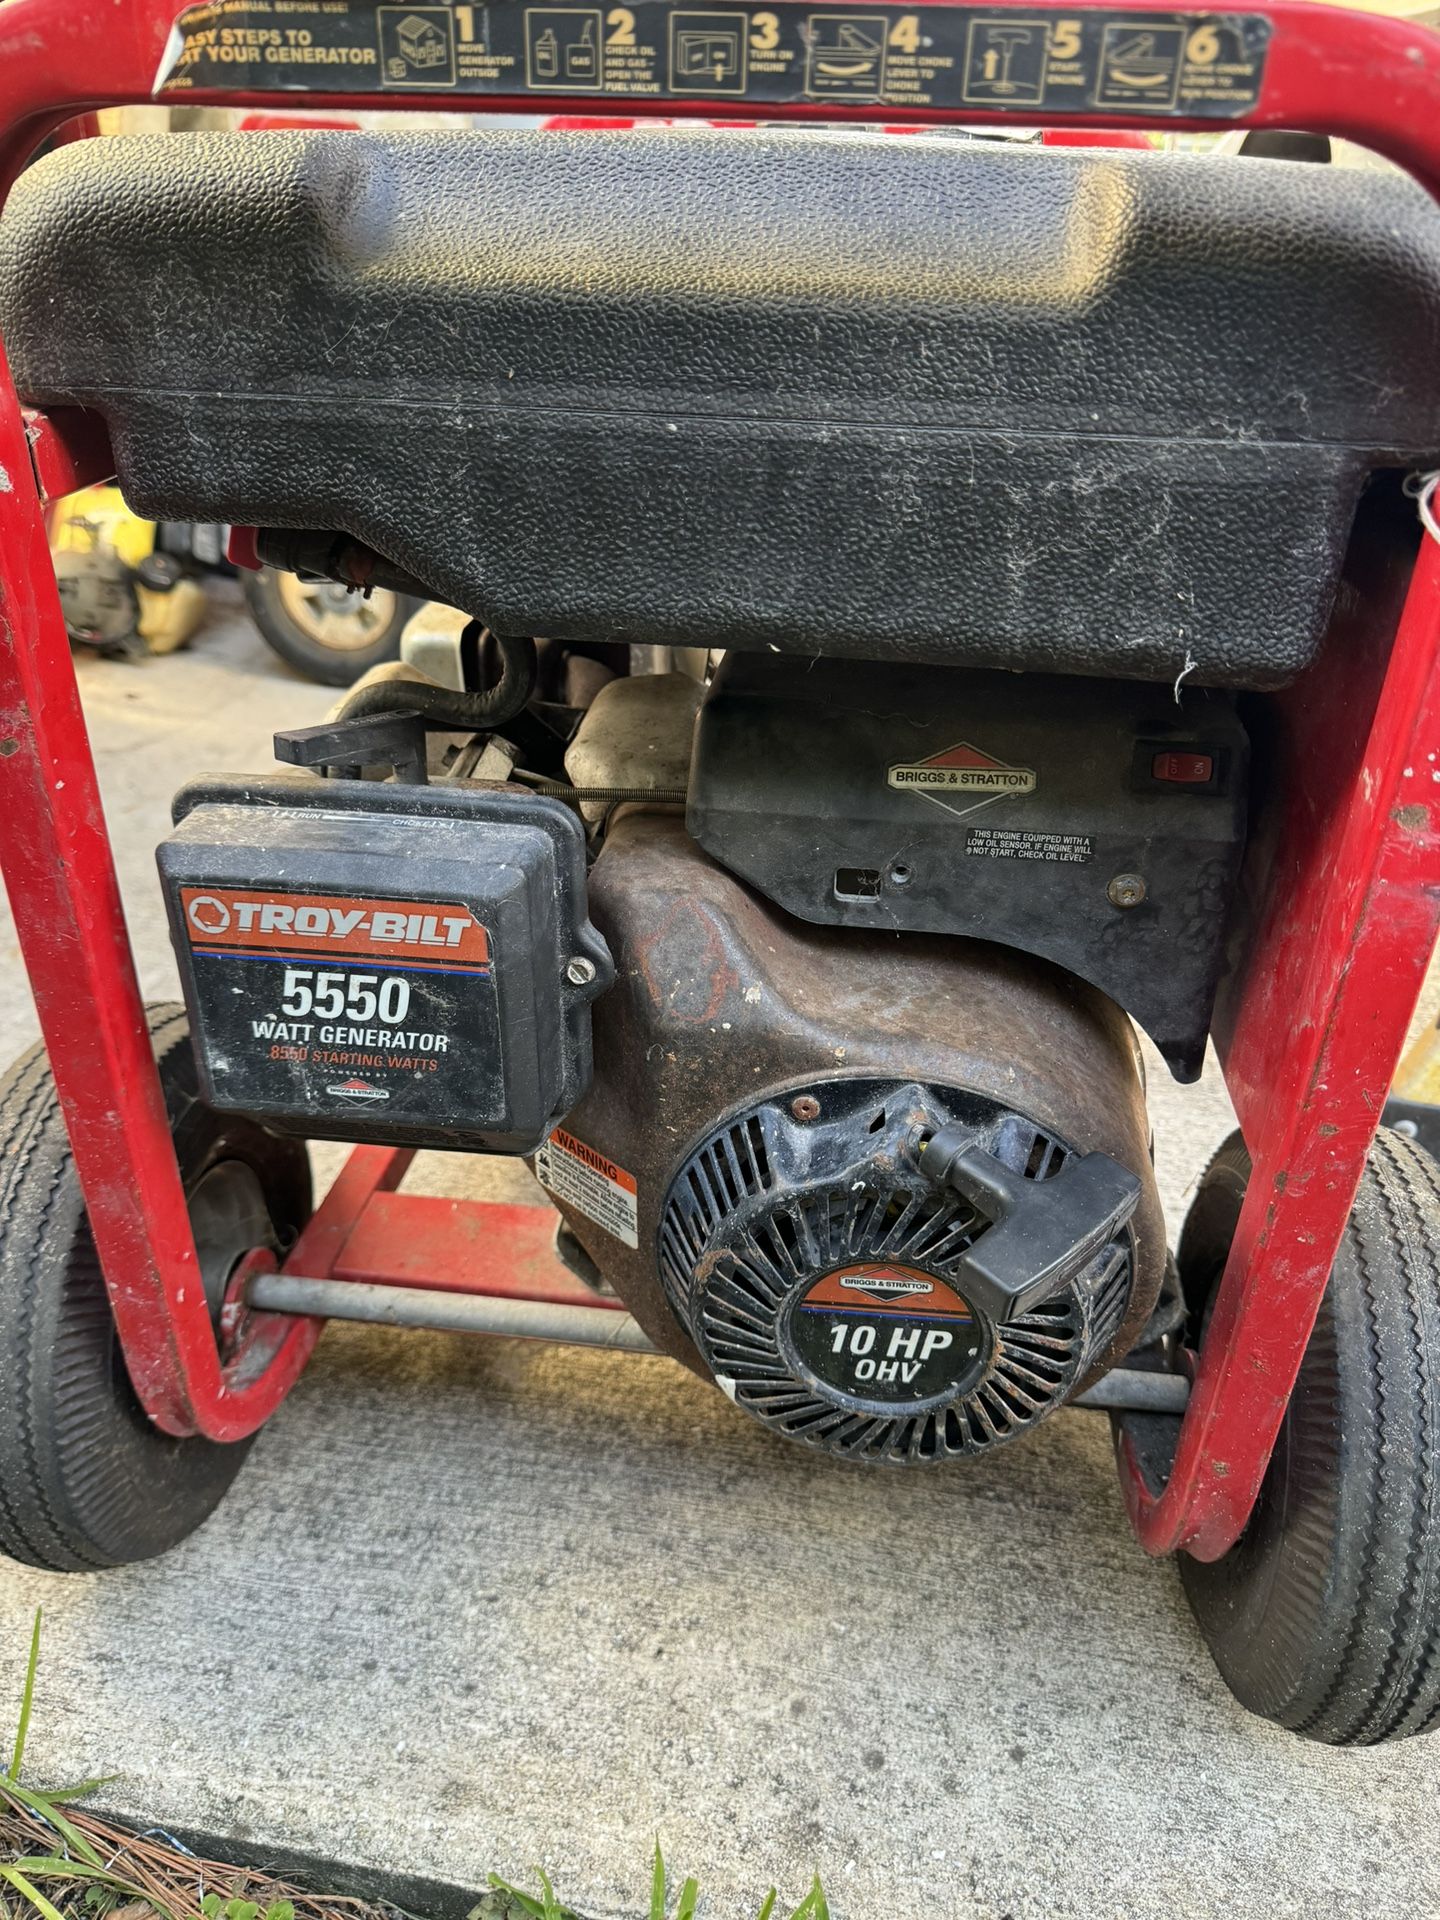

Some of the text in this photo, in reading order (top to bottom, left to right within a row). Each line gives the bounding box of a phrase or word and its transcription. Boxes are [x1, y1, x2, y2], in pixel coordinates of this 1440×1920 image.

[275, 2, 320, 12] BEFORE
[456, 6, 474, 42] 1
[606, 8, 636, 45] 2
[750, 12, 779, 49] 3
[221, 28, 282, 45] STEPS
[285, 29, 312, 46] TO
[889, 15, 920, 53] 4
[1050, 20, 1082, 59] 5
[458, 43, 485, 53] MOVE
[605, 46, 637, 56] CHECK
[1187, 25, 1219, 65] 6
[206, 45, 261, 62] YOUR
[265, 47, 376, 64] GENERATOR
[458, 55, 514, 66] GENERATOR
[571, 56, 591, 66] GAS
[605, 58, 625, 68] AND
[750, 50, 794, 60] TURN ON
[887, 55, 954, 68] MOVE CHOKE
[459, 67, 499, 78] OUTSIDE
[605, 70, 652, 80] OPEN THE
[749, 62, 786, 72] ENGINE
[886, 68, 934, 80] LEVER TO
[605, 82, 660, 93] FUEL VALVE
[886, 80, 920, 91] CHOKE
[896, 771, 1028, 786] BRIGGS & STRATTON
[974, 829, 1090, 846] THIS ENGINE EQUIPPED WITH A
[967, 838, 984, 846] LOW
[986, 839, 998, 848] OIL
[1000, 840, 1032, 850] SENSOR.
[1044, 843, 1073, 853] ENGINE
[1074, 846, 1091, 855] WILL
[973, 846, 1085, 863] NOT START, CHECK OIL LEVEL.
[233, 902, 472, 947] TROY-BILT
[281, 970, 410, 1024] 5550
[252, 1021, 448, 1052] WATT GENERATOR
[270, 1045, 438, 1072] 8550 STARTING WATTS
[557, 1129, 618, 1181] WARNING
[844, 1278, 929, 1290] BRIGGS & STRATTON
[830, 1324, 953, 1360] 10 HP
[855, 1359, 922, 1383] OHV
